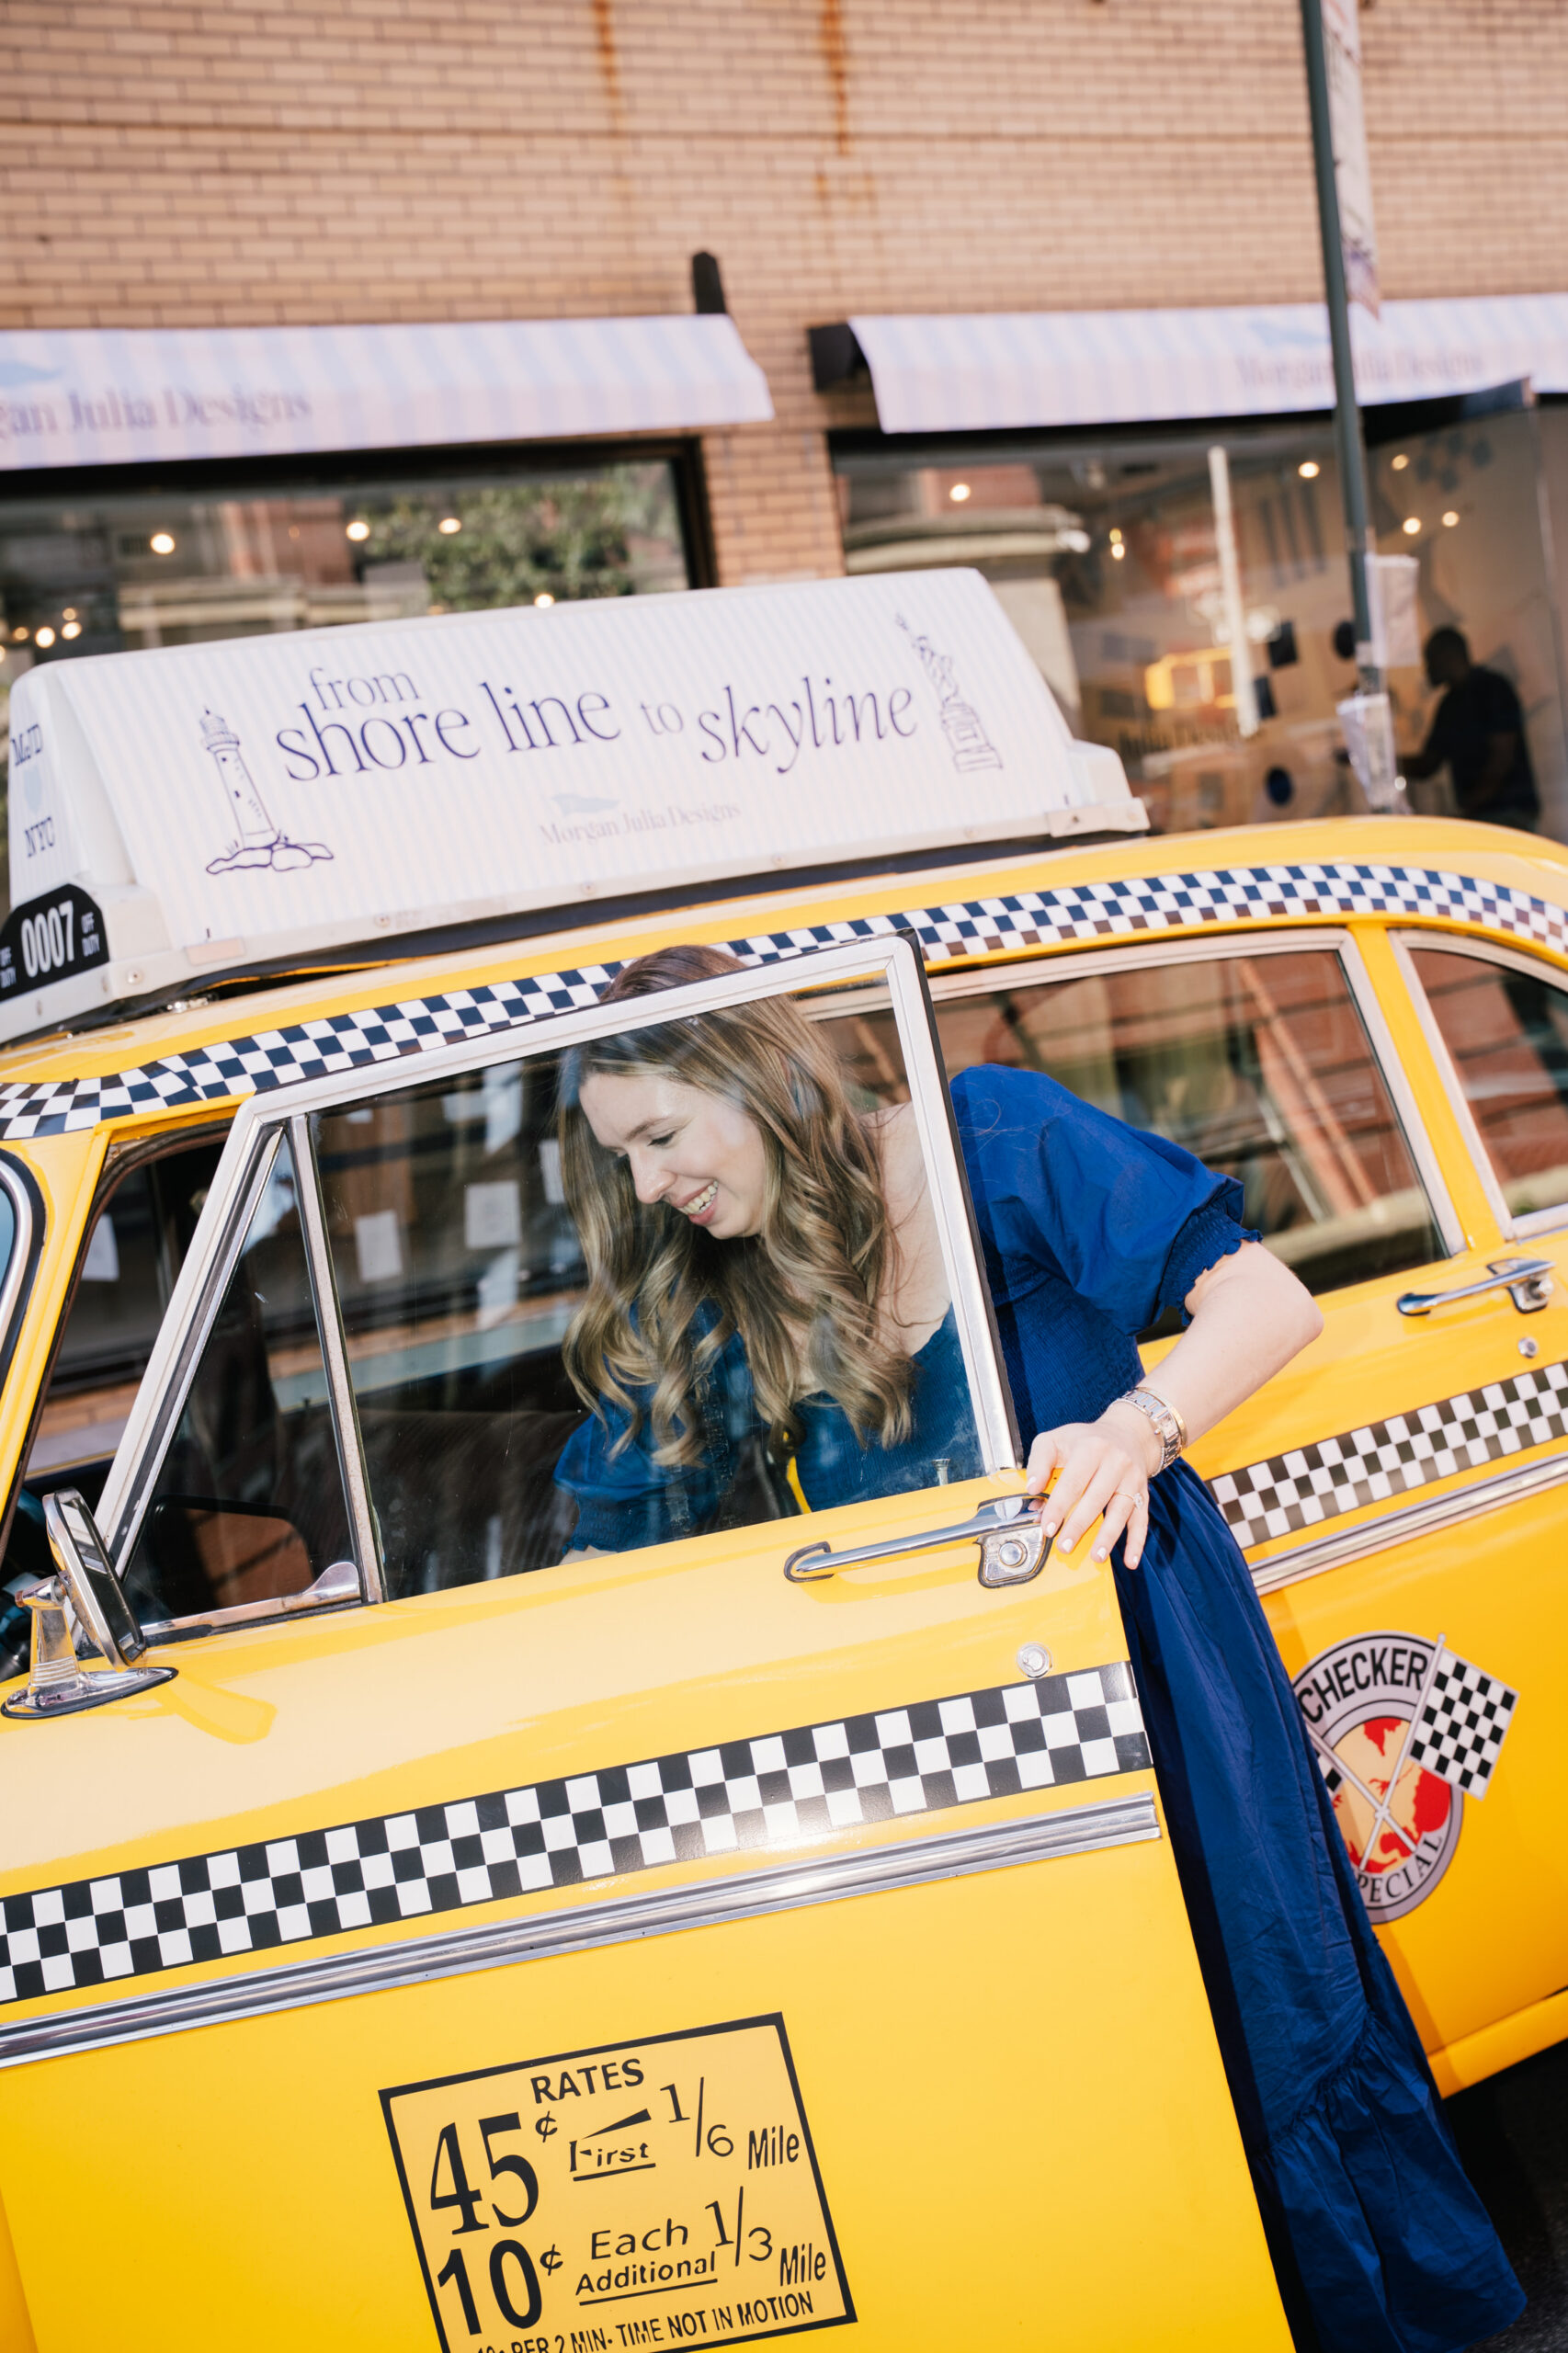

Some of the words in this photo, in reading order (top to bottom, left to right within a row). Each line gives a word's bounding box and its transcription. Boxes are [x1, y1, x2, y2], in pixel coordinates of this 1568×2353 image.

[68, 387, 158, 433] Julia
[165, 382, 312, 437] Designs
[309, 667, 422, 711] from
[276, 702, 482, 781] shore
[479, 682, 621, 752] line
[642, 702, 684, 735] to
[698, 676, 918, 774] skyline
[25, 816, 56, 858] NYC
[540, 823, 620, 845] Morgan
[621, 809, 668, 835] Julia
[667, 802, 743, 827] Designs
[21, 900, 74, 978] 0007
[1298, 1647, 1428, 1724] CHECKER
[1355, 1836, 1443, 1903] PECIAL
[530, 2058, 644, 2104] RATES
[569, 2109, 652, 2172] First
[748, 2125, 800, 2170] Mile
[575, 2250, 716, 2296] Additional
[591, 2218, 688, 2260] Each
[779, 2243, 826, 2286] Mile
[554, 2335, 565, 2353] 2
[615, 2318, 664, 2347] TIME
[667, 2310, 707, 2339] NOT
[711, 2305, 733, 2331] IN
[736, 2290, 814, 2326] MOTION
